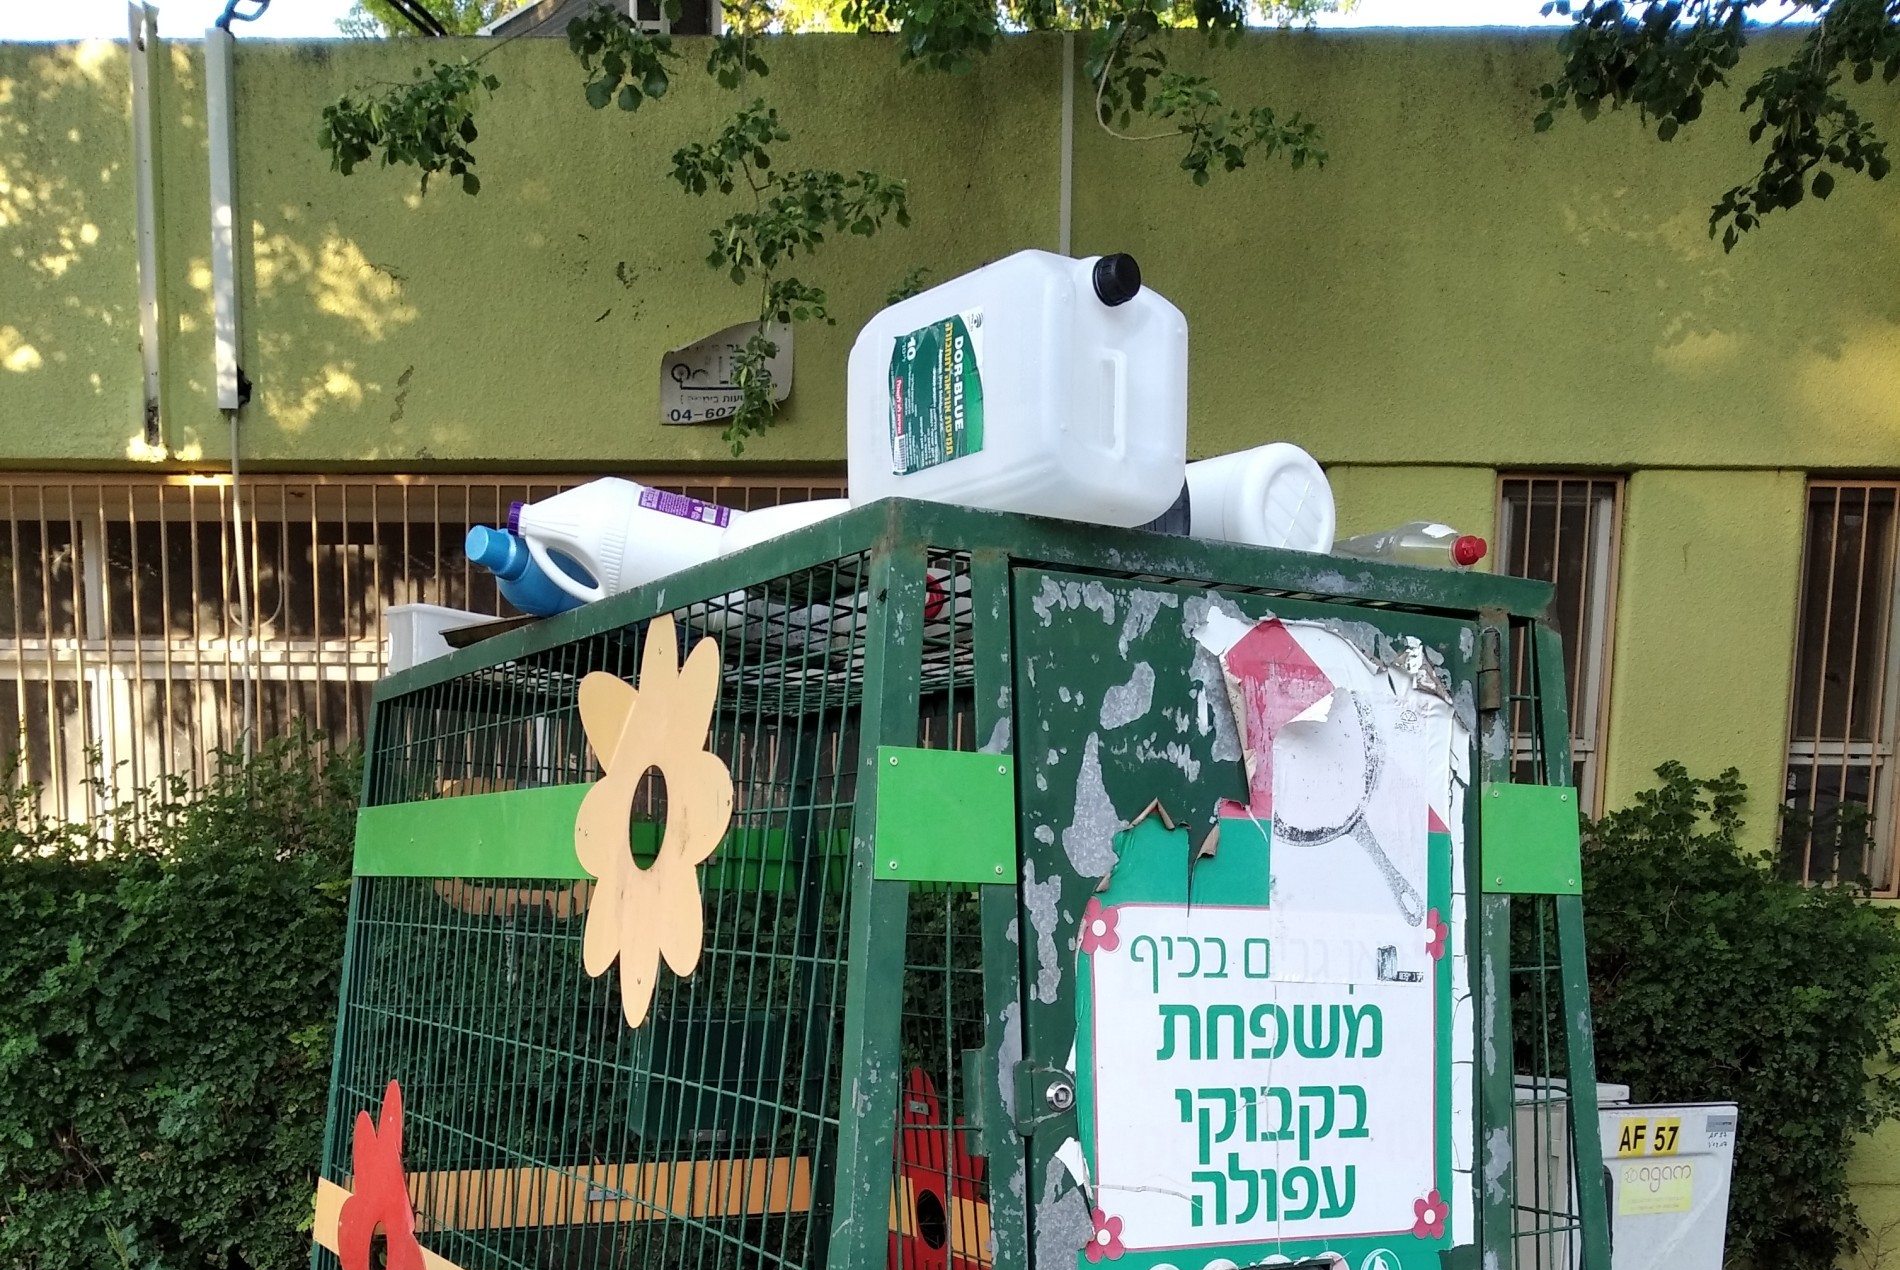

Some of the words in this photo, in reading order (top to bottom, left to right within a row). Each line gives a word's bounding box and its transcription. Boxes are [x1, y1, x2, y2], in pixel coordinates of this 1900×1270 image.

[906, 336, 917, 362] 10
[953, 335, 964, 432] DOR-BLUE
[670, 406, 737, 422] 04-607
[945, 415, 954, 455] תמיסת
[1130, 934, 1228, 994] בכיף
[1156, 1003, 1383, 1061] משפחת
[1175, 1084, 1370, 1165] בקבוקי
[1619, 1125, 1647, 1152] AF
[1654, 1126, 1680, 1151] 57
[1191, 1152, 1356, 1227] עפולה
[1639, 1165, 1692, 1193] agam
